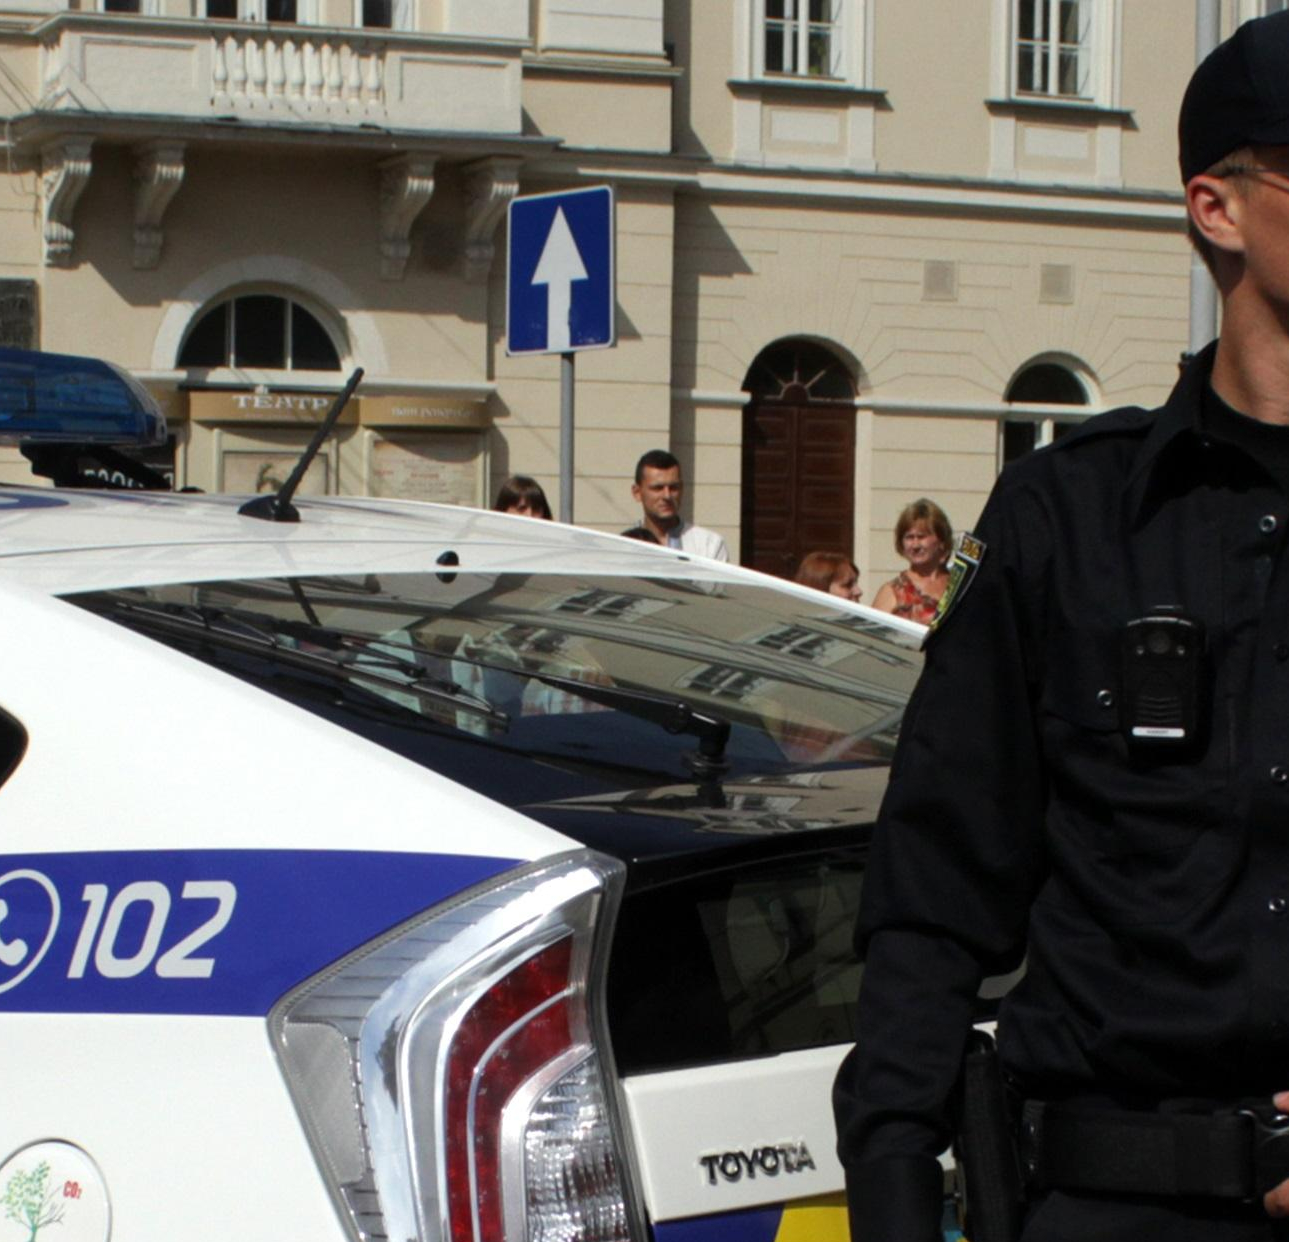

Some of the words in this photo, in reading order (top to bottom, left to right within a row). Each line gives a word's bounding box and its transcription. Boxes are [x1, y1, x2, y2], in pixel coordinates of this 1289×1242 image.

[232, 393, 329, 411] ТЕАТР
[66, 880, 238, 979] 102
[699, 1140, 816, 1186] TOYOTA
